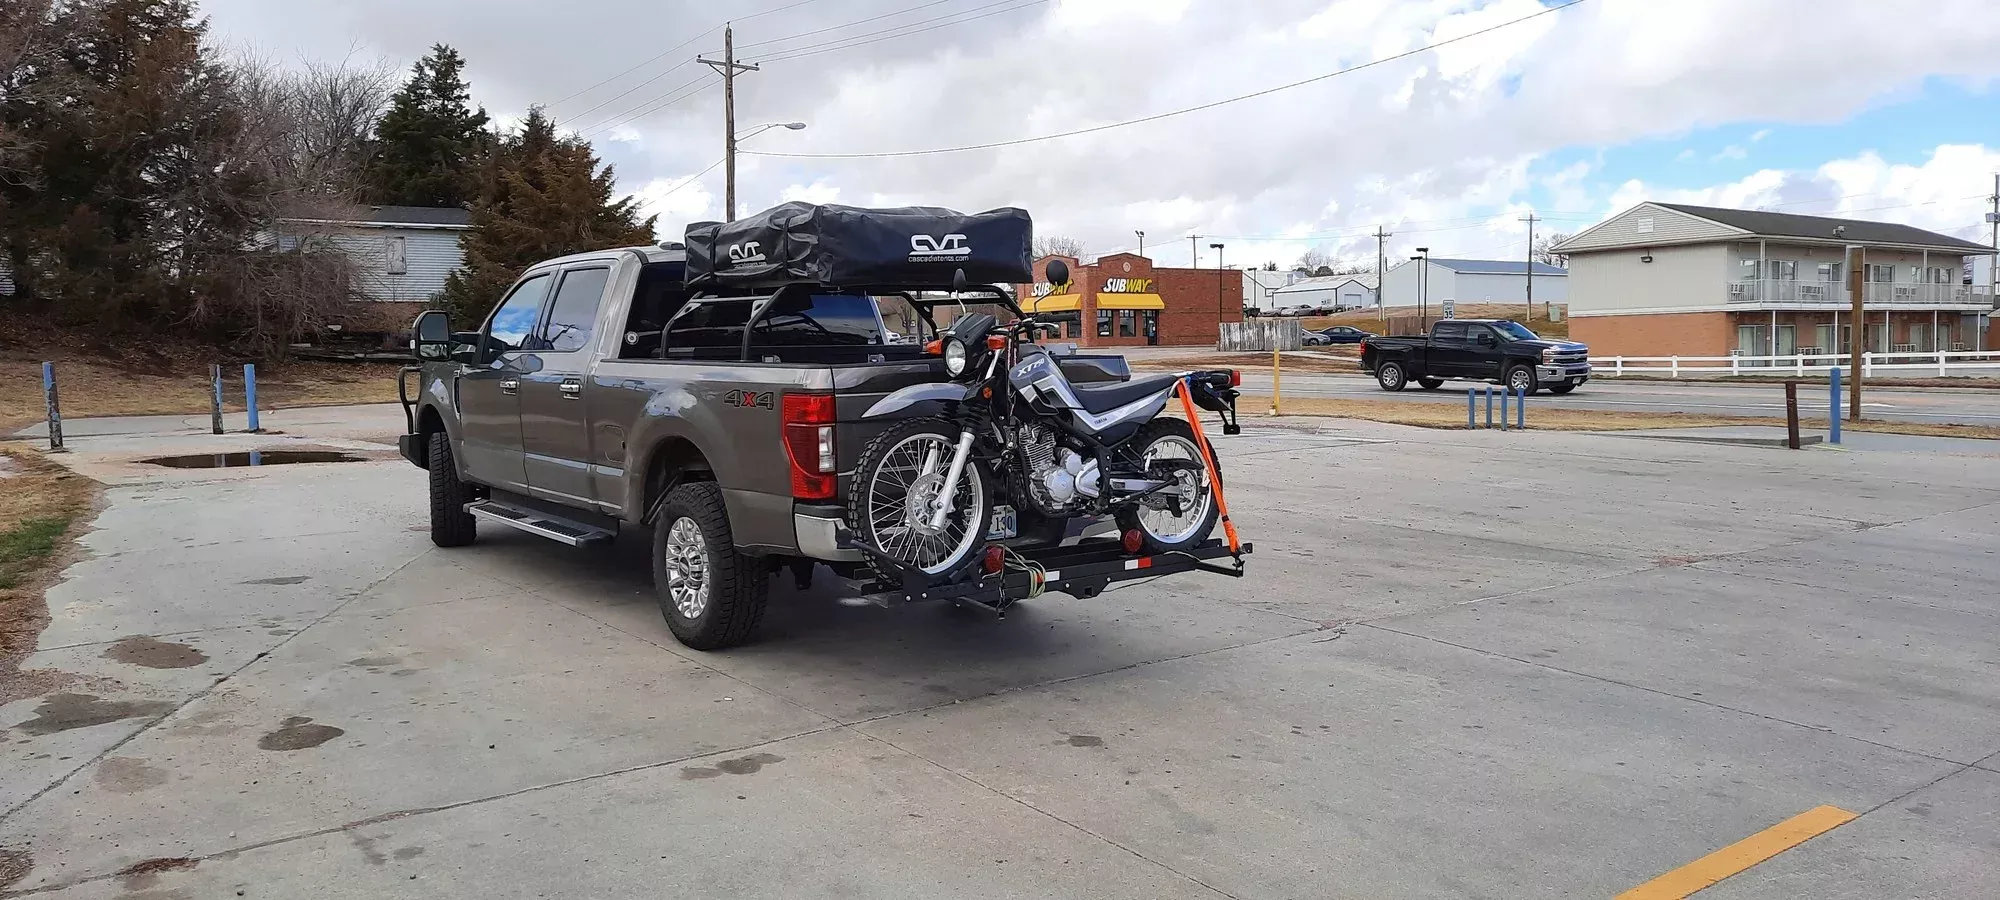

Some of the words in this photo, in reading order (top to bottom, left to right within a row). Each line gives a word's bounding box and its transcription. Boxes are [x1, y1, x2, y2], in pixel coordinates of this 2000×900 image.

[729, 241, 761, 260] CVT
[910, 233, 968, 251] CVT
[1103, 277, 1153, 293] SUBWAY
[1444, 310, 1453, 319] 35
